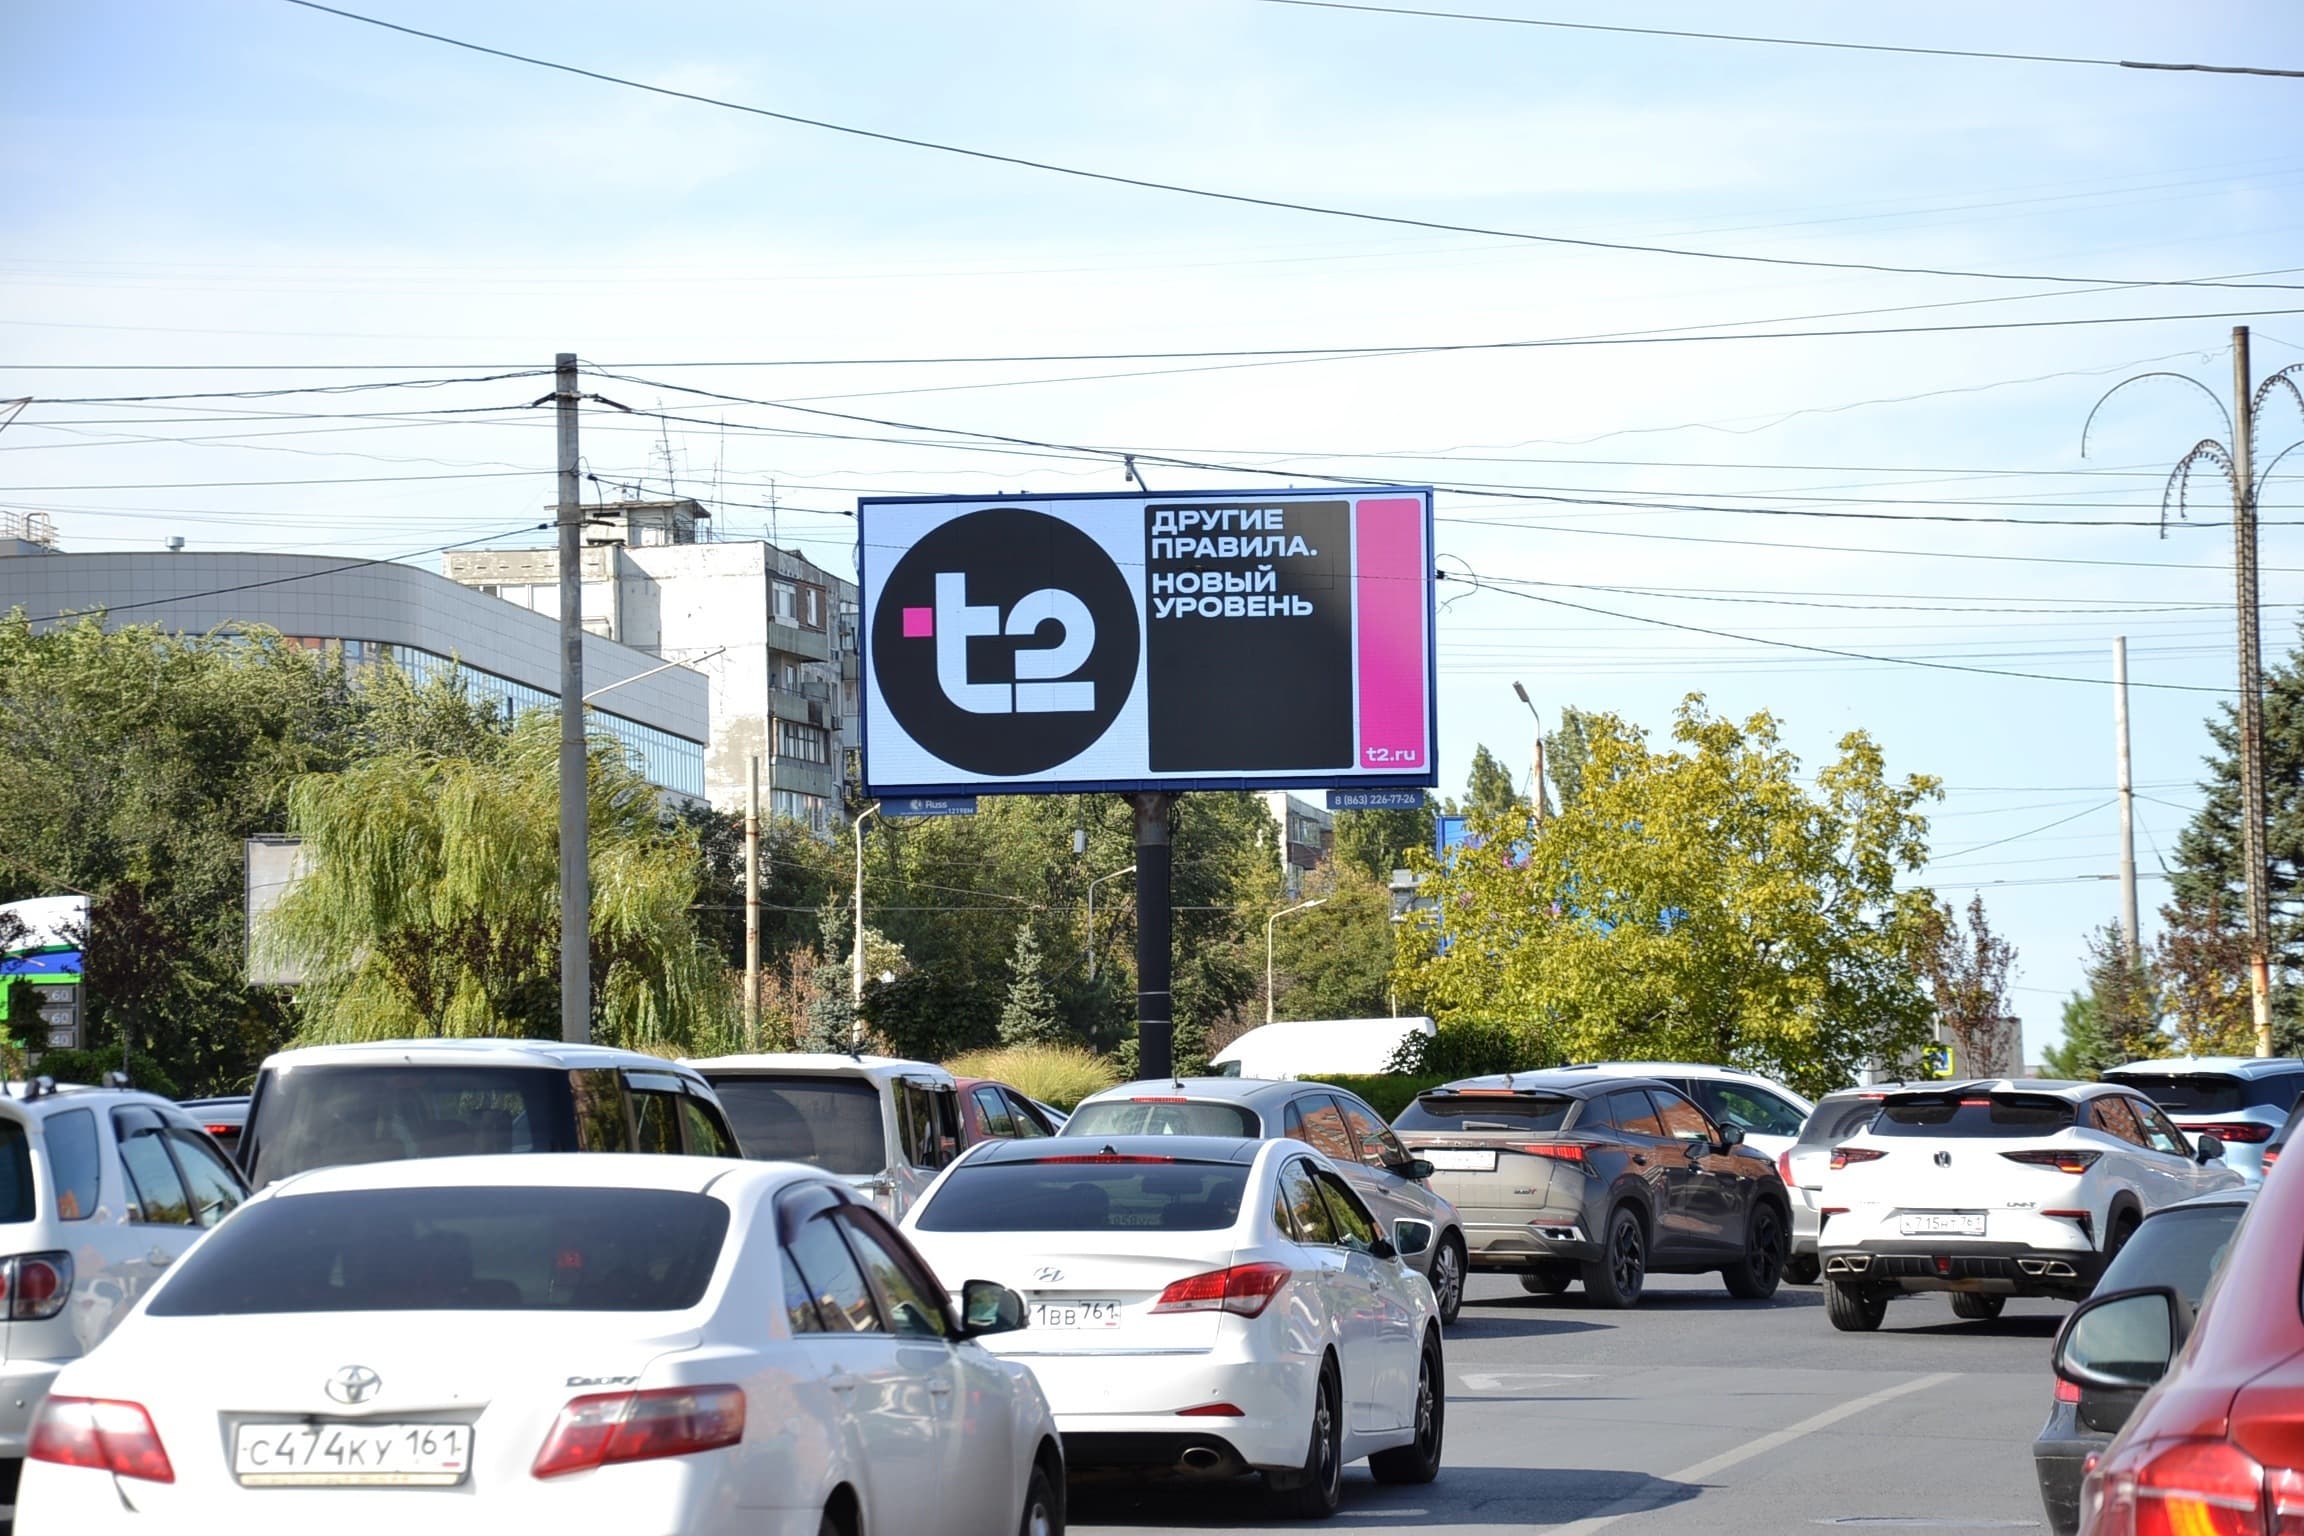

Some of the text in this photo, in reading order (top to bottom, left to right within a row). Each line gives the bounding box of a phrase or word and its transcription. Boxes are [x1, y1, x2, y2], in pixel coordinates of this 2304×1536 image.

[1152, 509, 1284, 536] ДРУГИЕ
[1152, 535, 1318, 559] ПРАВИЛА.
[1152, 564, 1276, 594] НОВЫЙ
[1153, 595, 1313, 619] УРОВЕНЬ
[935, 572, 1096, 714] t2
[1365, 747, 1416, 762] t2.ru
[925, 800, 948, 809] Russ
[1335, 794, 1416, 806] 8 (863) 226-77-26
[1081, 1303, 1115, 1320] 761
[406, 1430, 457, 1456] 161
